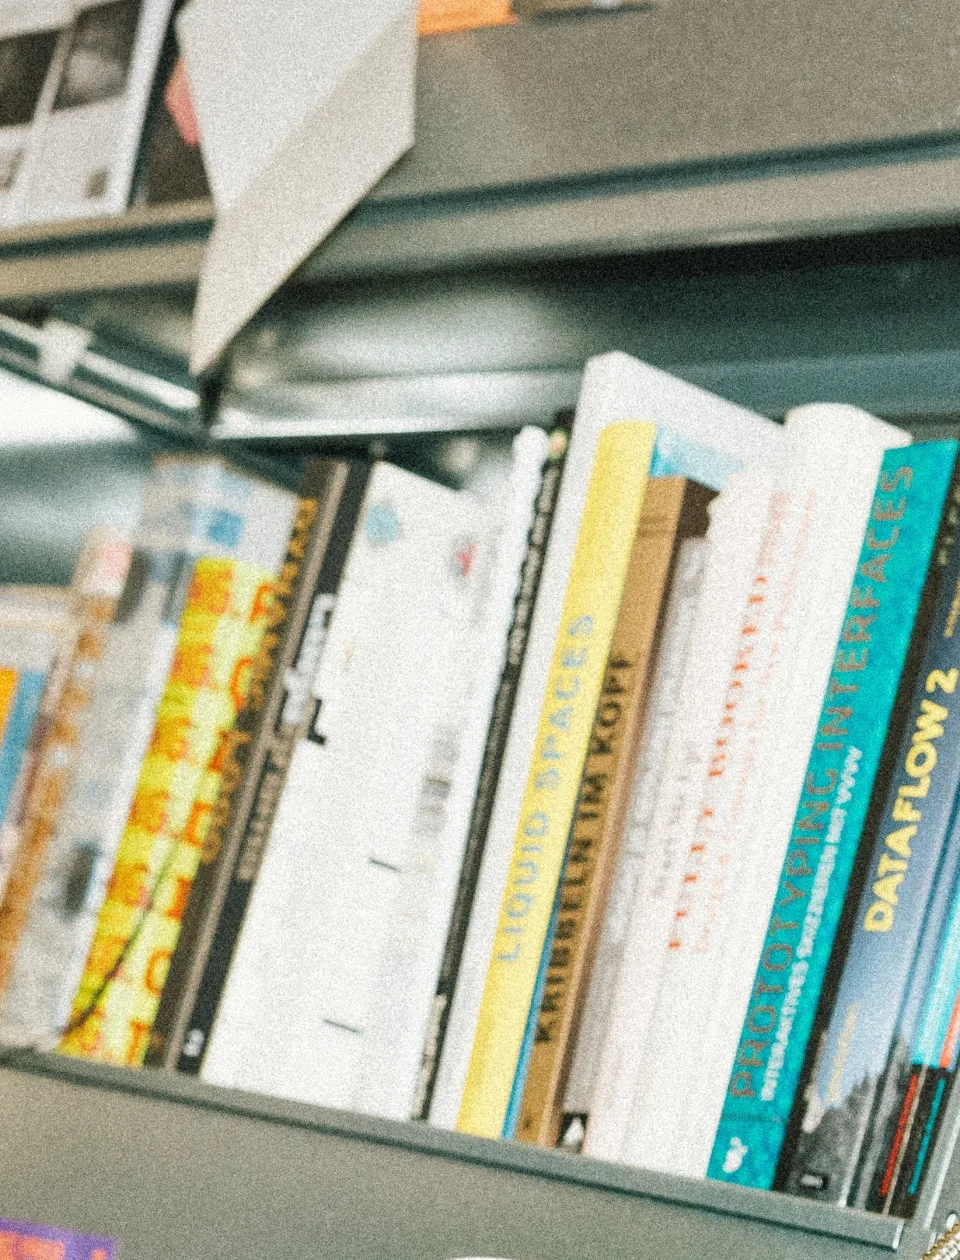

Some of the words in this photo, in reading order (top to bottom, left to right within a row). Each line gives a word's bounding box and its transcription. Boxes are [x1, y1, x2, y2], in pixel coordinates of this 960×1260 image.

[497, 810, 550, 963] LIQUID
[534, 613, 595, 791] SPACES
[576, 773, 609, 821] IM
[590, 658, 633, 756] KOPF
[730, 768, 838, 1098] PROTOTYPING
[816, 465, 914, 751] INTERFACES
[863, 698, 949, 933] DATAFLOW
[925, 667, 960, 694] 2
[760, 959, 809, 1101] INTERAKTIVES
